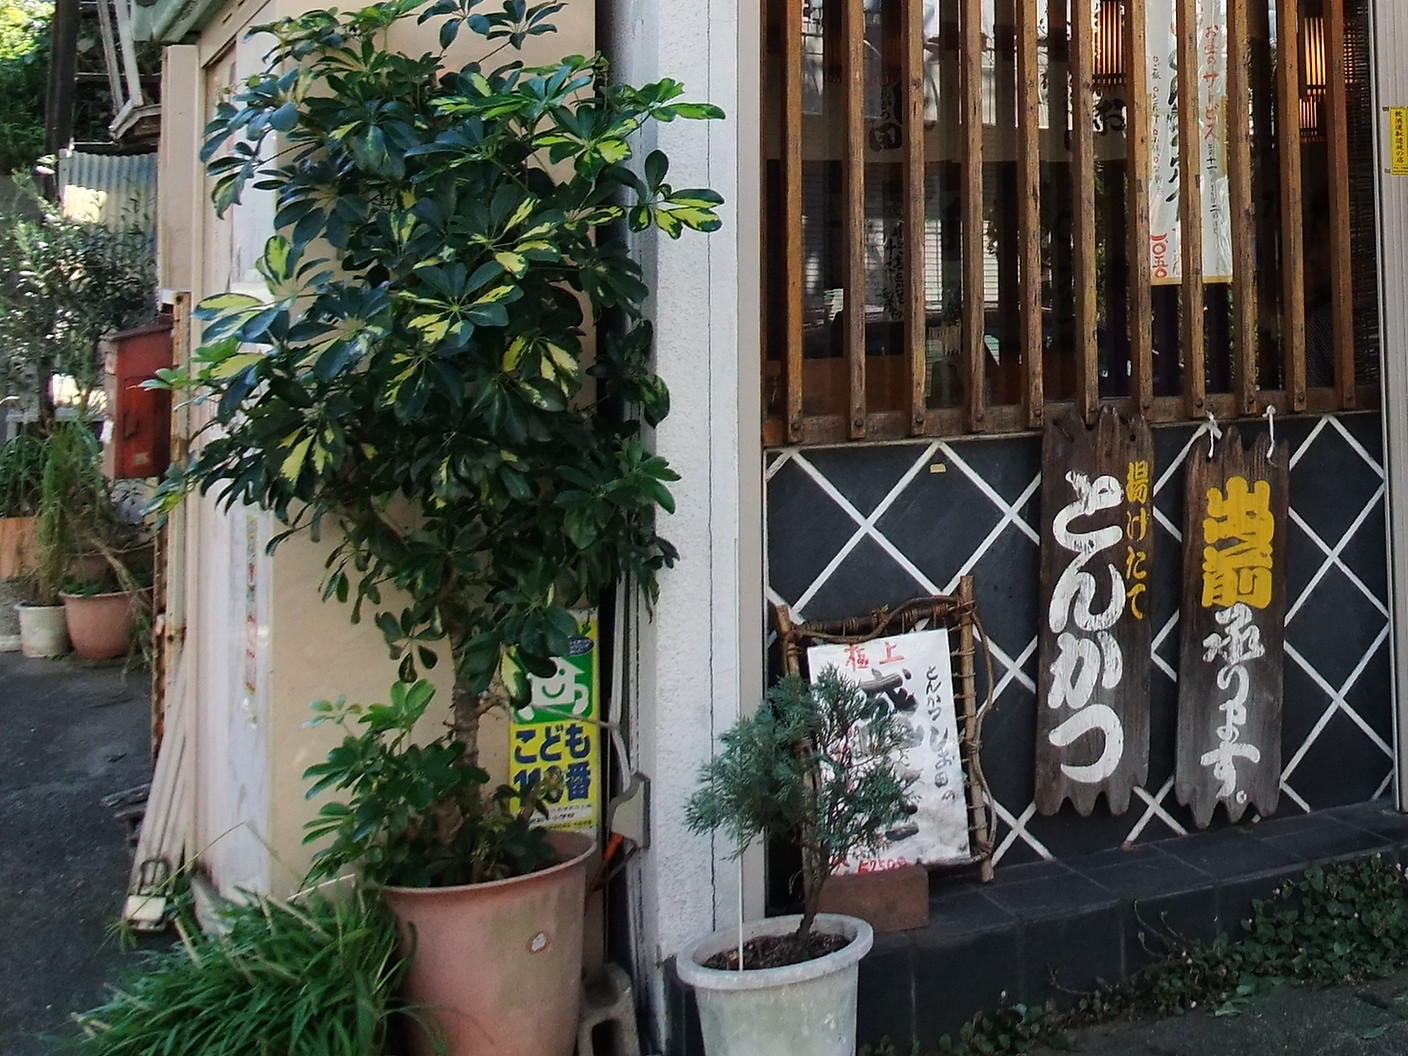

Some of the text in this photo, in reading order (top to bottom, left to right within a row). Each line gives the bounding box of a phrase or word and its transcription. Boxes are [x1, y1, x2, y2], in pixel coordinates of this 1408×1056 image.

[1048, 470, 1126, 784] とんかつ
[514, 722, 591, 765] こども
